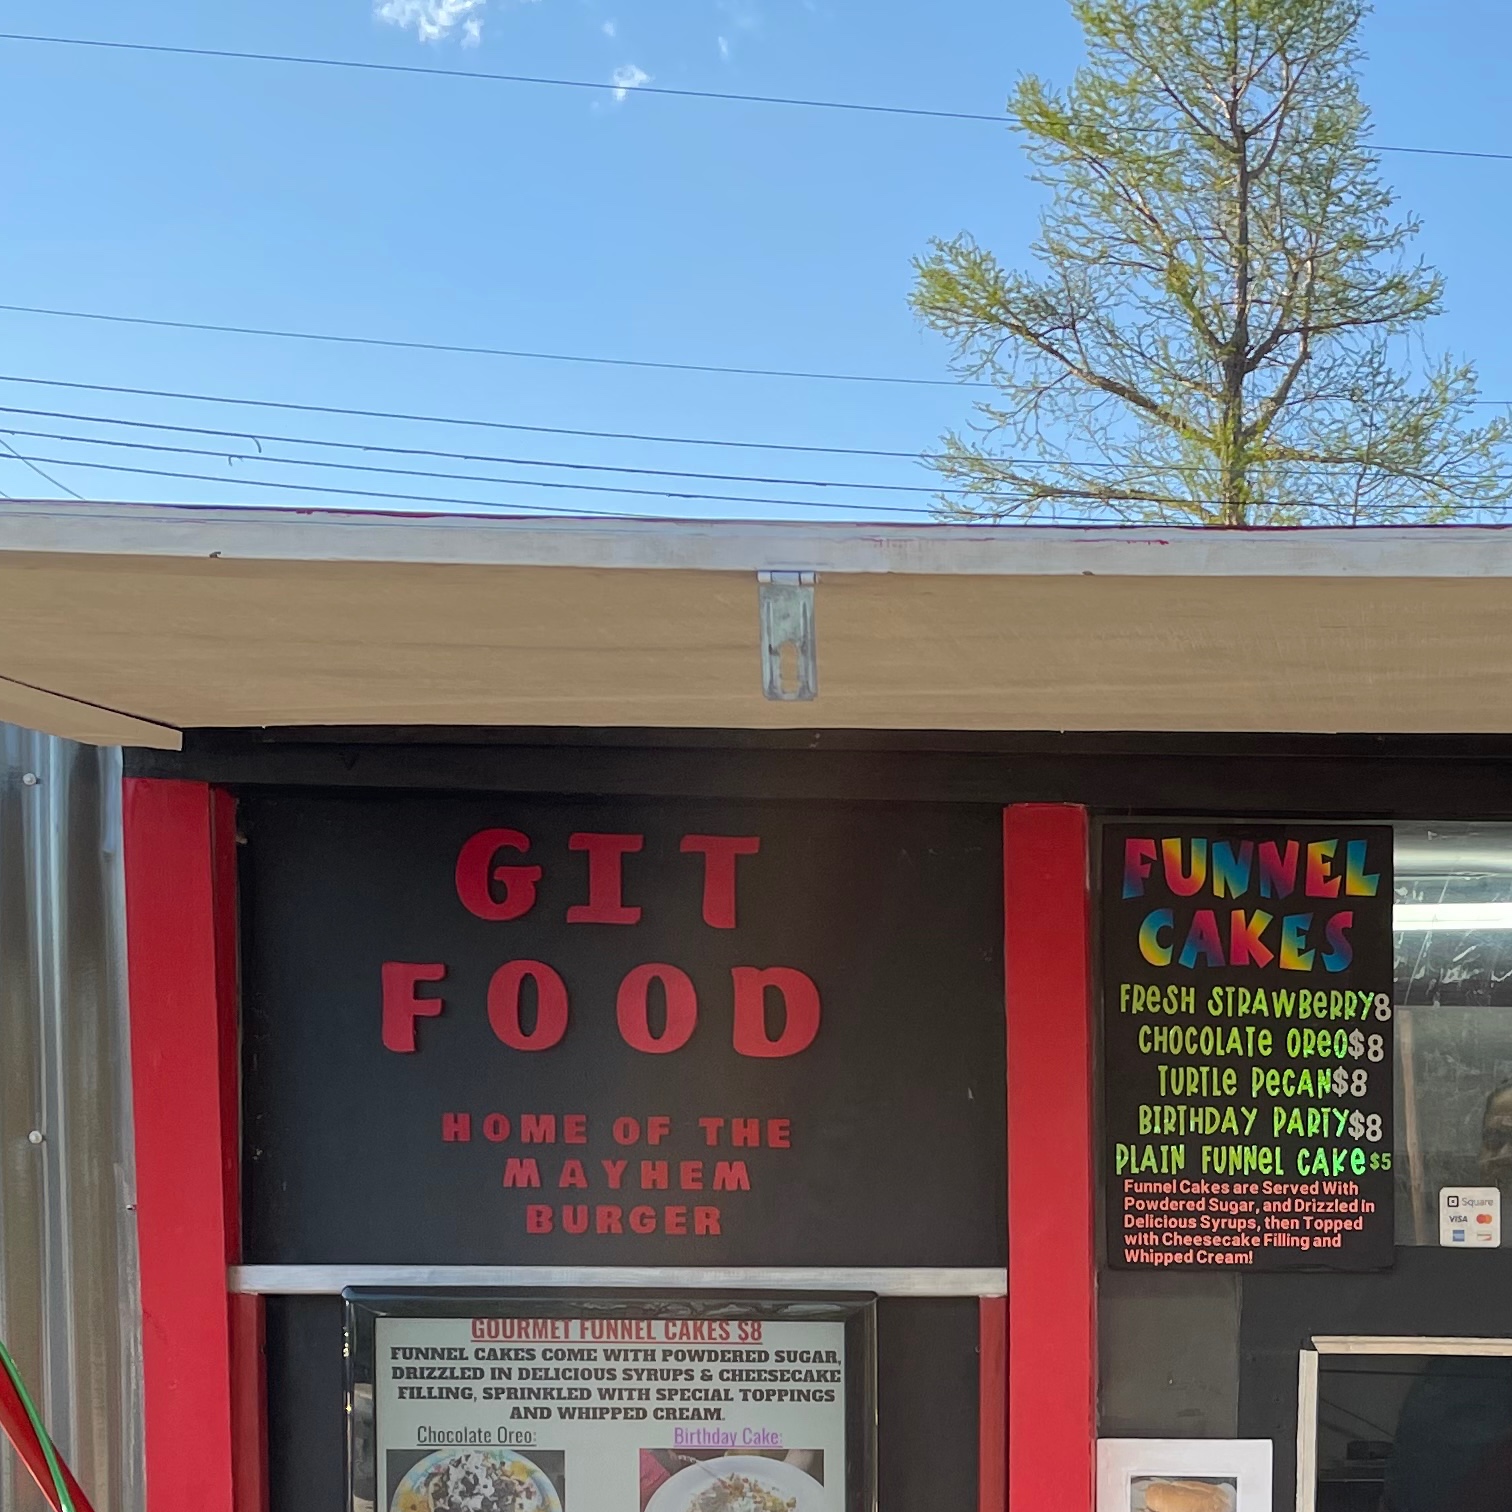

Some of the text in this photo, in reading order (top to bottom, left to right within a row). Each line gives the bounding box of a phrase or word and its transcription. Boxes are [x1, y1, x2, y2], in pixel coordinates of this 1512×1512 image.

[455, 827, 761, 929] GIT
[1121, 837, 1381, 900] FUNNEL
[1138, 908, 1354, 972] CAKES
[381, 959, 821, 1058] FOOD
[442, 1112, 791, 1148] HOME OF THE
[1138, 1104, 1258, 1137] BIRTHDAY
[1115, 1143, 1186, 1176] PLAIN
[1369, 1152, 1392, 1171] $5
[503, 1157, 751, 1191] MAYHEM
[1124, 1178, 1359, 1196] Funnel Cakes are Served With
[1124, 1196, 1359, 1215] Powdered Sugar, and Drizzled
[1461, 1197, 1494, 1208] Square
[525, 1204, 722, 1236] BURGER
[1124, 1214, 1364, 1233] Delicious Syrups, then Topped
[1449, 1215, 1468, 1223] VISA
[1124, 1231, 1342, 1250] with Cheesecake Filling and
[1124, 1249, 1253, 1266] Whipped Cream!
[471, 1317, 763, 1343] GOURMET FUNNEL CAKES $8
[390, 1346, 842, 1366] FUNNEL CAKES COME WITH POWDERED SUGAR,
[391, 1366, 841, 1383] DRIZZLED IN DELICIOUS SYRUPS & CHEESECAKE
[397, 1386, 835, 1402] FILLING, SPRINKLED WITH SPECIAL TOPPINGS
[510, 1406, 726, 1421] AND WHIPPED CREAM.
[417, 1425, 537, 1444] Chocolate Oreo:
[673, 1427, 783, 1446] Birthday Cake:
